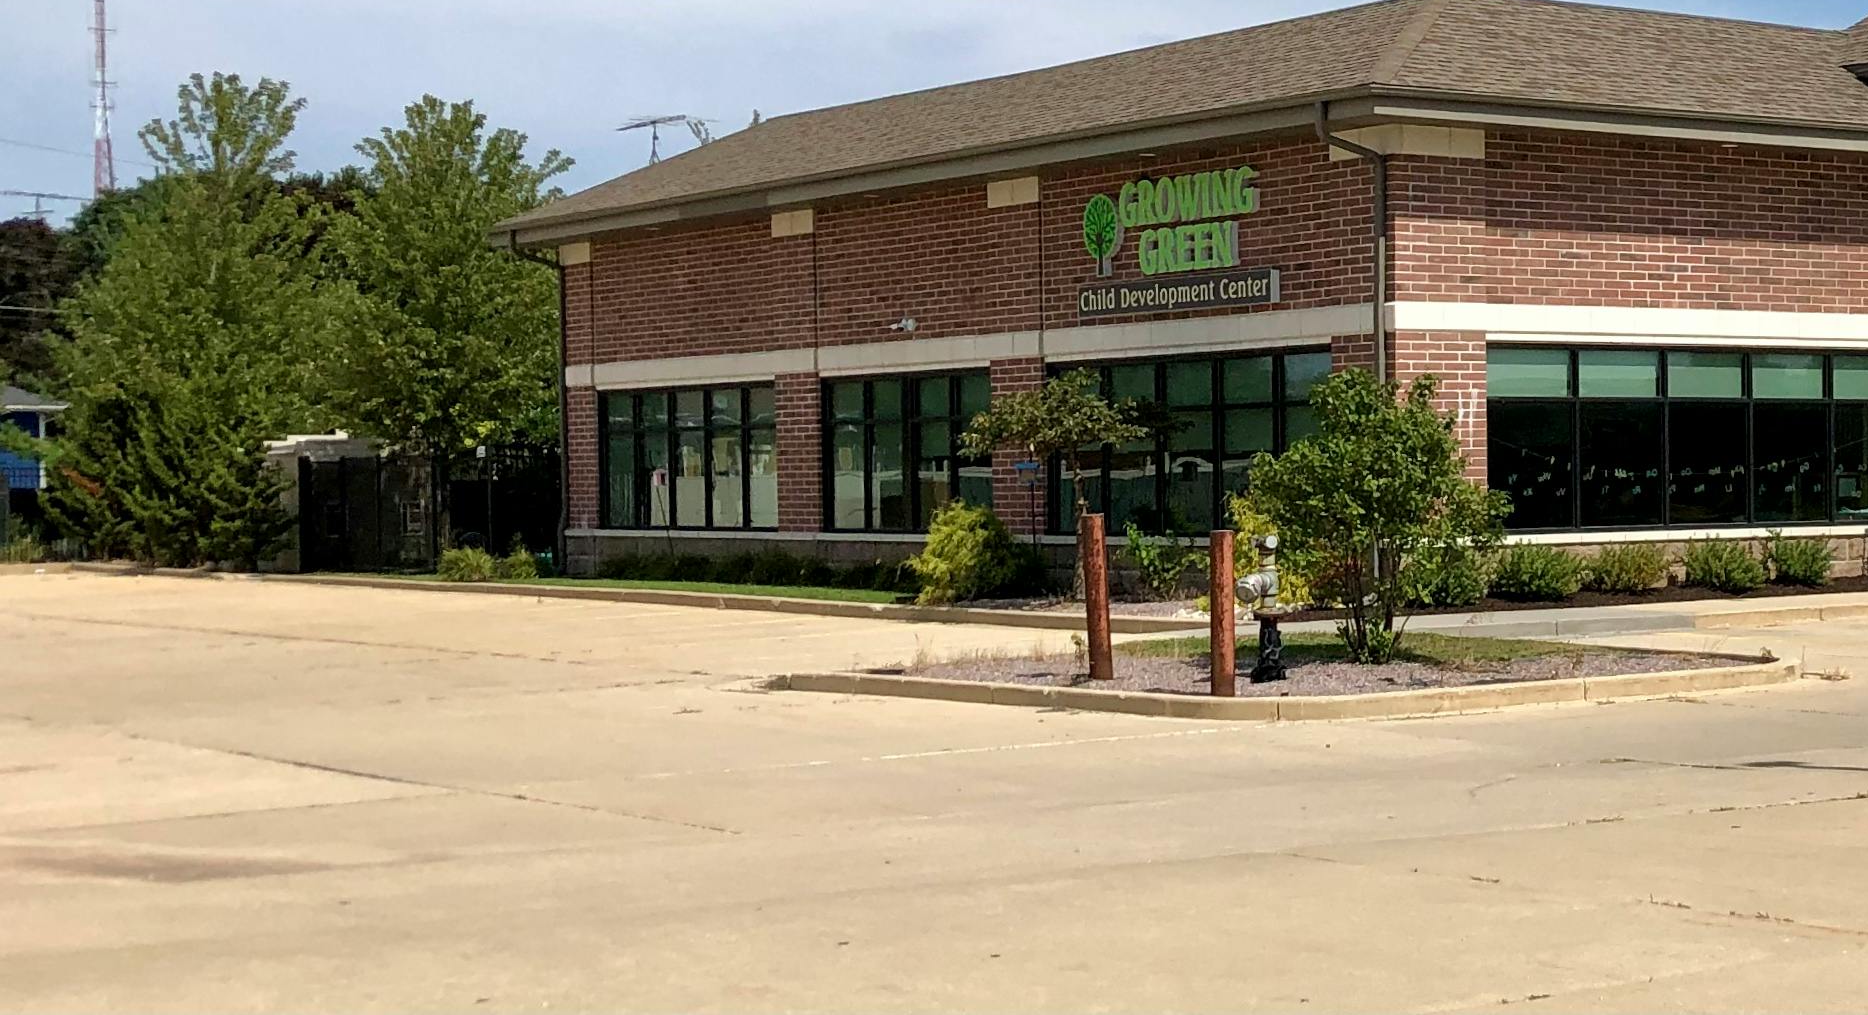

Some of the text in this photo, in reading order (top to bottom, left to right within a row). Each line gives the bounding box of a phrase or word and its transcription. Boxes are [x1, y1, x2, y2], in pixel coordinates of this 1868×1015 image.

[1118, 166, 1258, 228] GROWING
[1139, 220, 1236, 275] GREEN
[1080, 277, 1268, 312] Child Development Center
